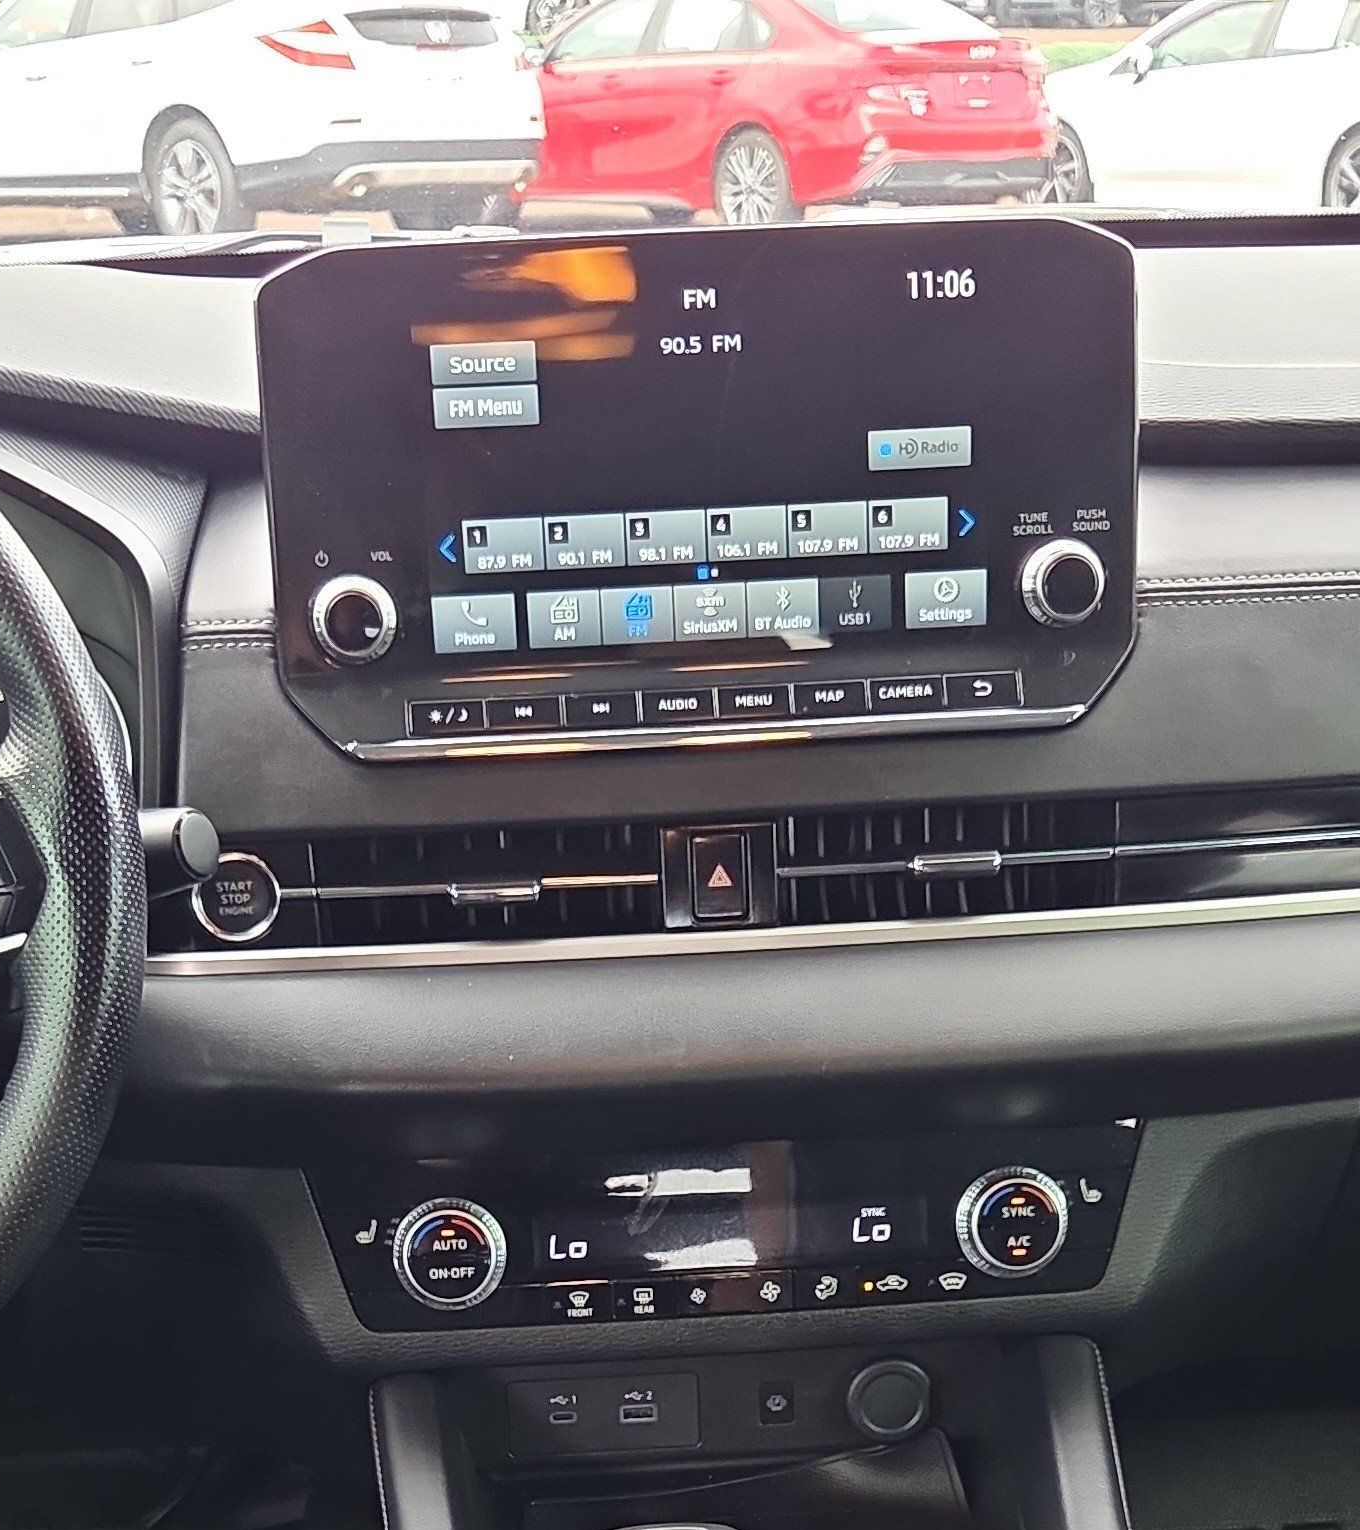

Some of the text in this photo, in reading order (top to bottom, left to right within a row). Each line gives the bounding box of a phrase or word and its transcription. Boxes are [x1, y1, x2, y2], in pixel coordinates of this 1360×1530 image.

[906, 268, 976, 299] 11:06
[683, 288, 716, 309] FM
[660, 335, 742, 354] 90.5 FM
[449, 357, 516, 374] Source
[449, 398, 522, 418] FM Menu
[921, 441, 959, 455] Radio
[796, 513, 807, 528] 5
[877, 509, 888, 524] 6
[1019, 511, 1049, 524] TUNE
[1076, 508, 1106, 520] PUSH
[634, 520, 645, 536] 3
[715, 516, 727, 532] 4
[1012, 524, 1054, 537] SCROLL
[1072, 520, 1111, 532] SOUND
[472, 529, 482, 544] 1
[553, 525, 564, 541] 2
[797, 538, 859, 554] 107.9 FM
[879, 533, 940, 550] 107.9 FM
[370, 550, 393, 562] VOL
[639, 546, 693, 562] 98.1 FM
[717, 542, 778, 558] 106.1 FM
[477, 554, 533, 571] 87.9 FM
[558, 550, 613, 566] 90.1 FM
[838, 612, 871, 626] USB1
[918, 606, 973, 623] Settings
[683, 619, 738, 635] SiriusXM
[754, 615, 812, 631] BT Audio
[454, 631, 496, 646] Phone
[554, 627, 576, 642] AM
[628, 625, 649, 638] FM
[814, 689, 845, 703] MAP
[878, 683, 933, 700] CAMERA
[658, 697, 698, 711] AUDIO
[734, 693, 773, 708] MENU
[216, 881, 253, 893] START
[220, 893, 251, 905] STOP
[219, 906, 254, 915] ENGINE
[861, 1207, 887, 1218] SYNC
[1001, 1206, 1036, 1218] SYNC
[852, 1217, 891, 1243] Lo
[433, 1238, 468, 1251] AUTO
[549, 1234, 588, 1260] Lo
[1007, 1236, 1032, 1249] A/C
[566, 1307, 593, 1317] FRONT
[645, 1390, 653, 1401] 2
